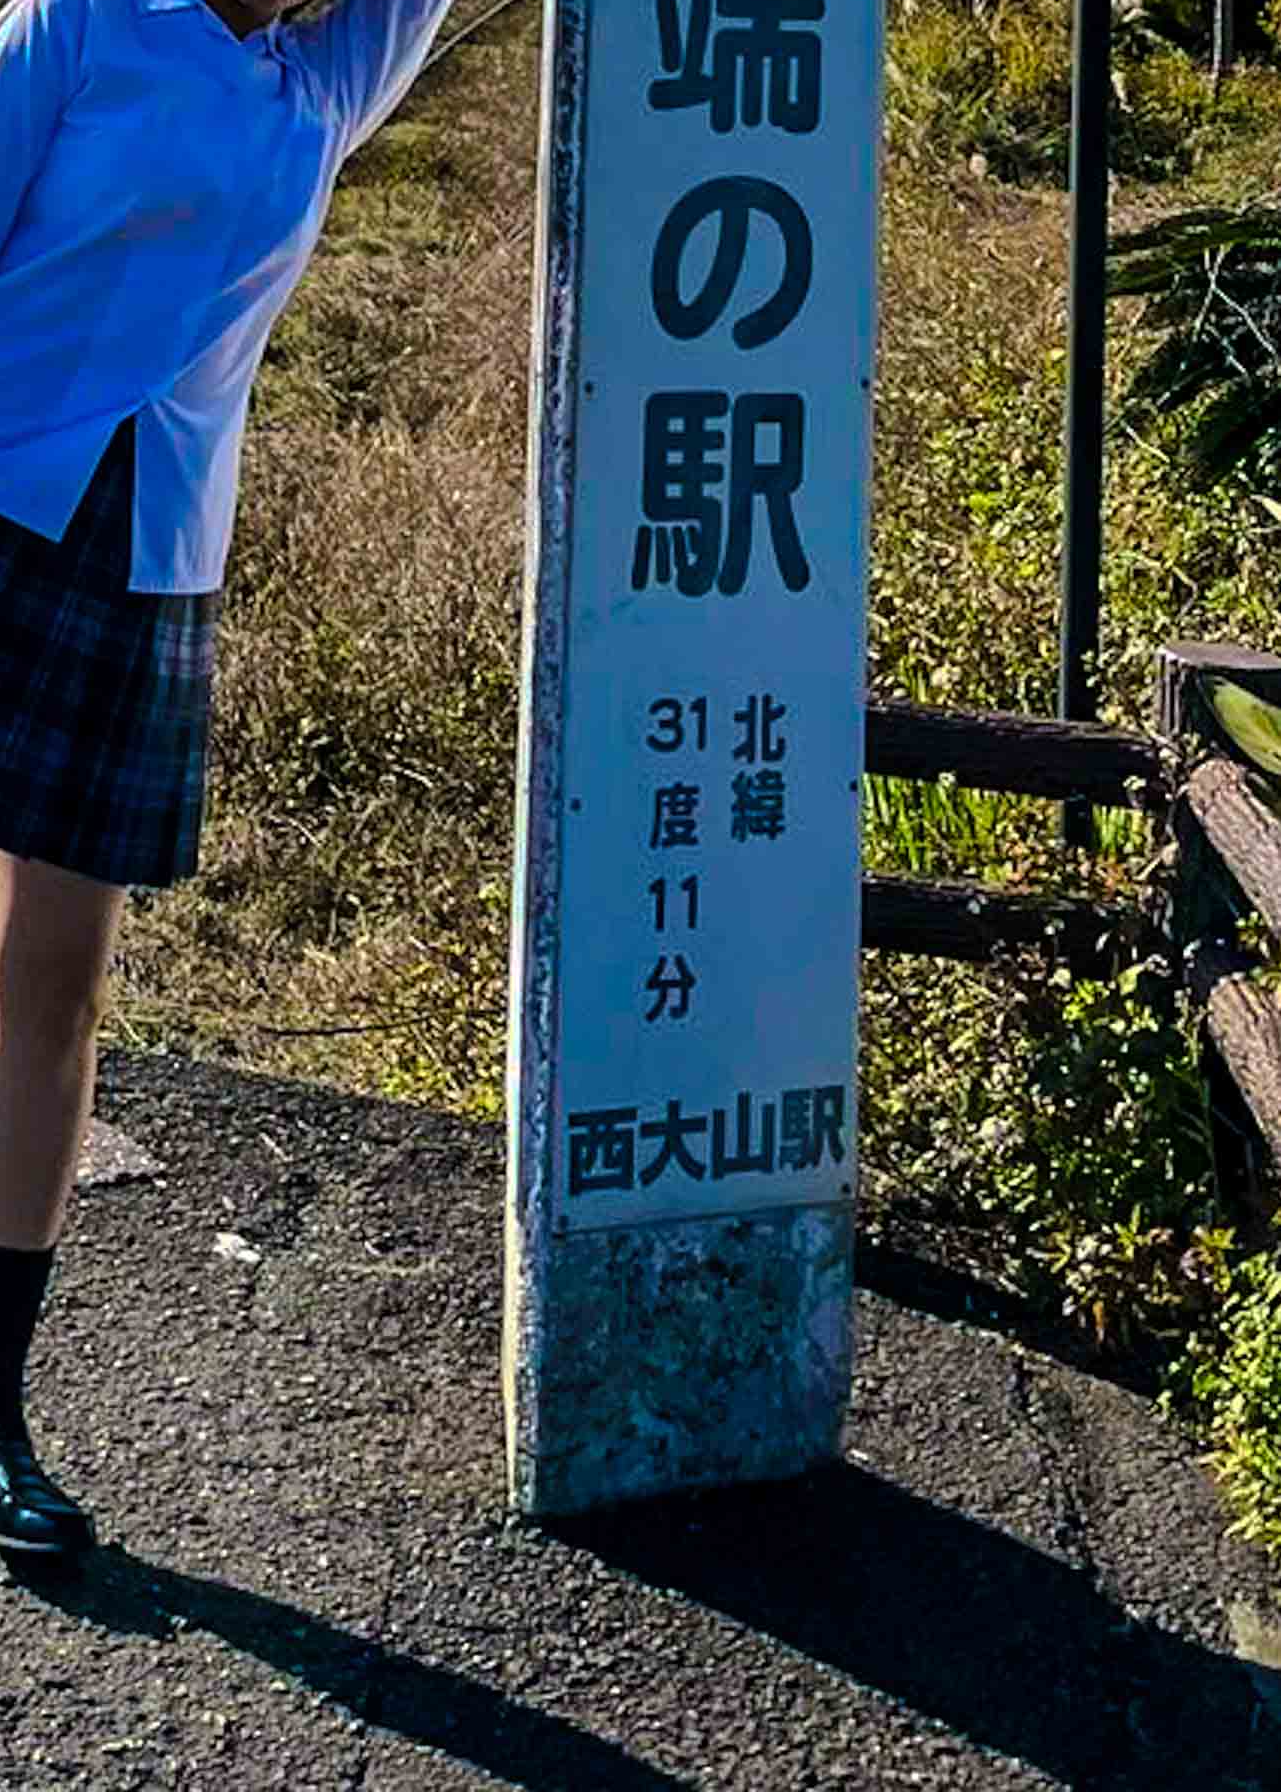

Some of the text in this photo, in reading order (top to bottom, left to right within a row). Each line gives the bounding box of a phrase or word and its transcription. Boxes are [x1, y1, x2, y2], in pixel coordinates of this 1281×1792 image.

[730, 695, 787, 843] 北緯
[567, 1085, 847, 1194] 西大山駅
